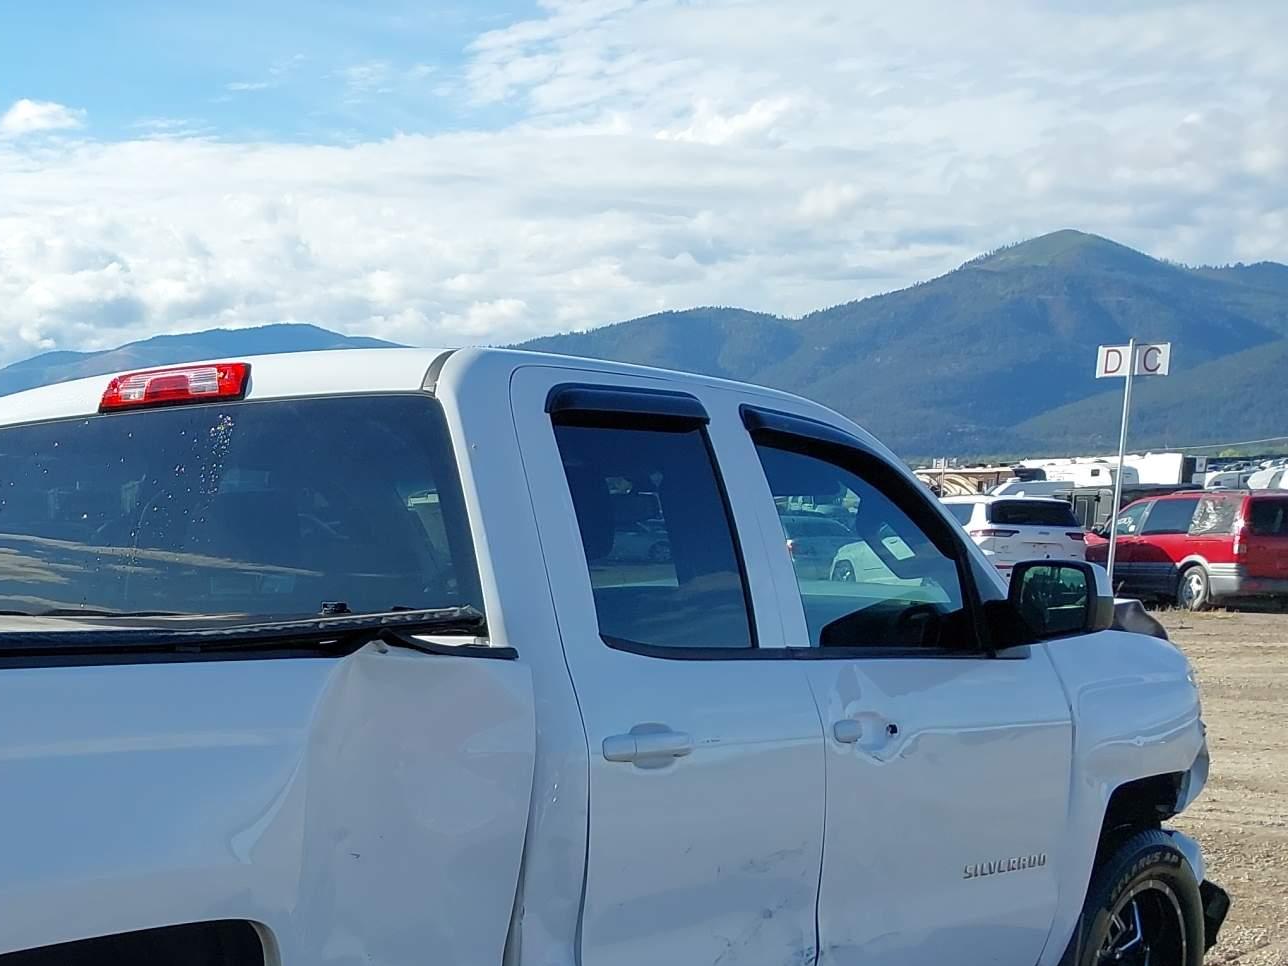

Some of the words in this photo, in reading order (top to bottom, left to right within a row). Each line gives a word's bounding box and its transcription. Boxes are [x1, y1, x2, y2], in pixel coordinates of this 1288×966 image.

[1103, 348, 1122, 374] D
[1144, 346, 1162, 372] C
[963, 852, 1048, 880] SILVERADO
